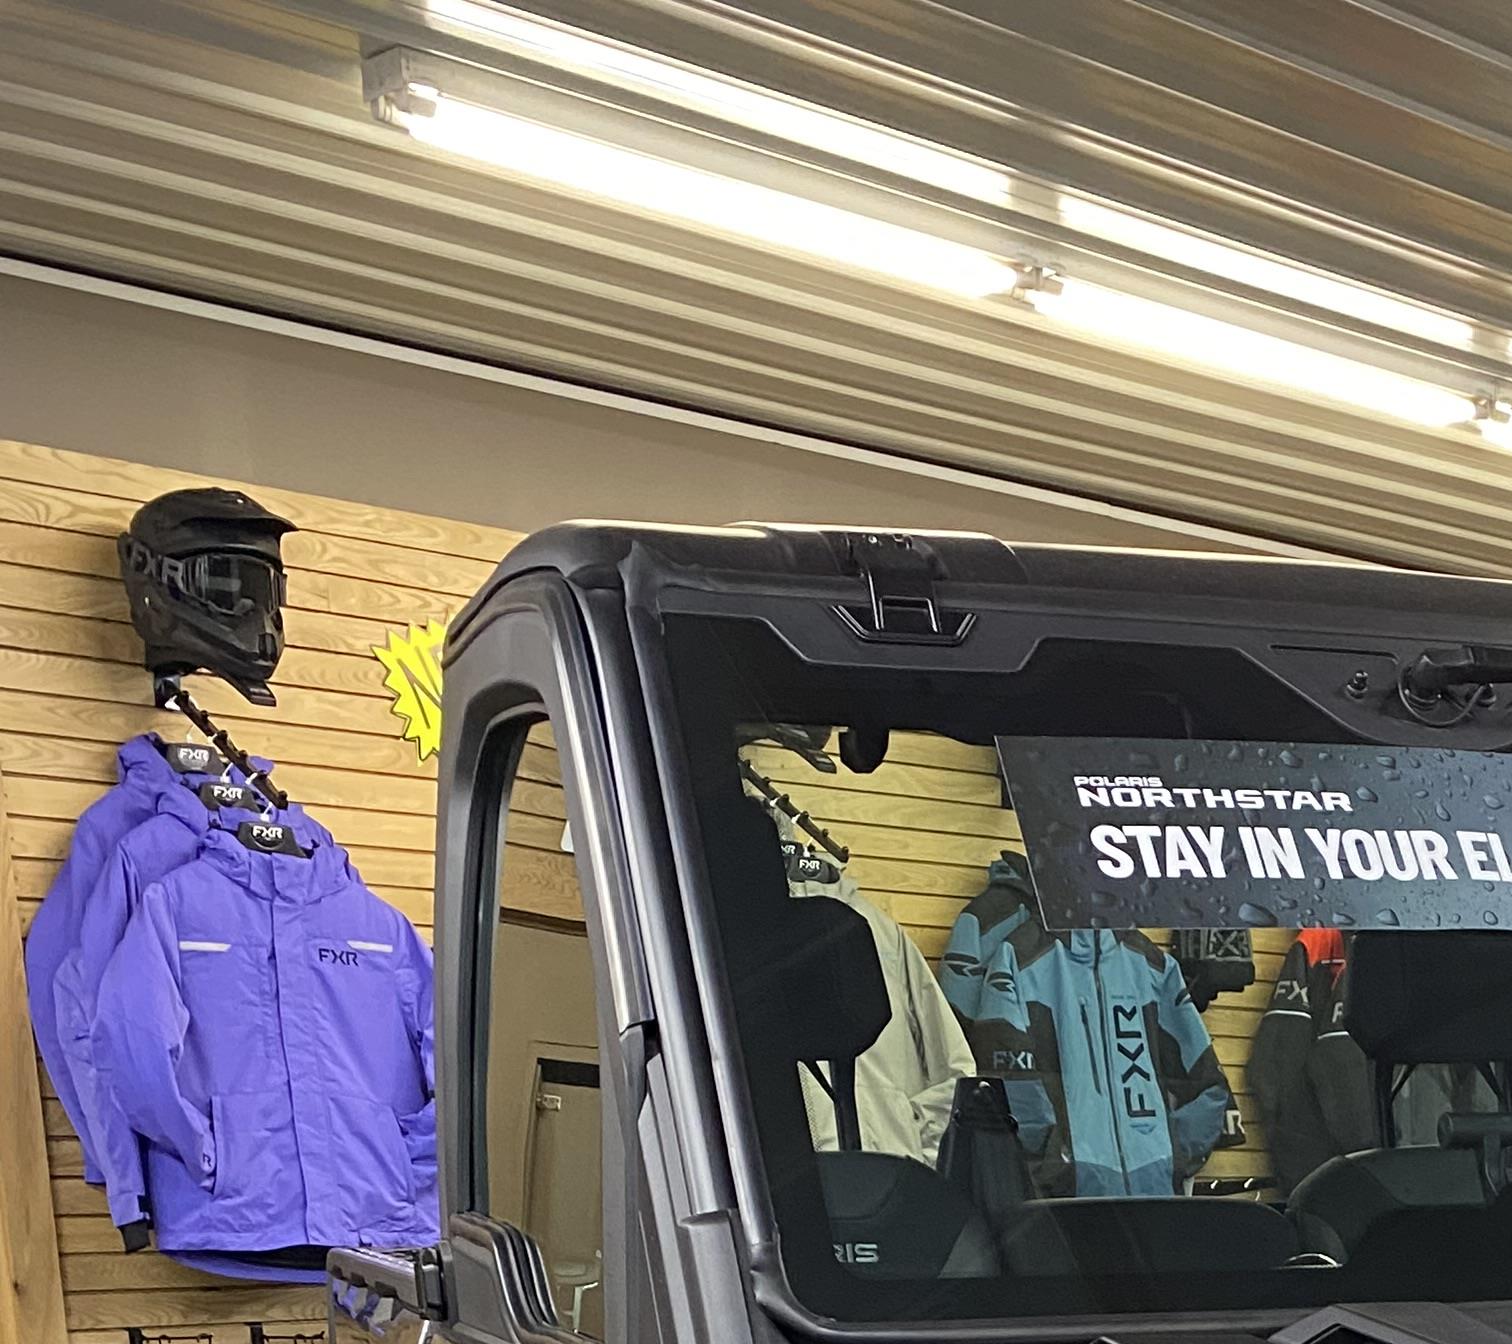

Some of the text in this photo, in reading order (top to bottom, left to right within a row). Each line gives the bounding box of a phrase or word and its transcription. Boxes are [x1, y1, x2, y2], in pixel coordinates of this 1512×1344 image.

[179, 748, 209, 762] FXR
[1073, 775, 1163, 788] POLARIS
[213, 785, 242, 799] FXR
[1076, 787, 1354, 813] NORTHSTAR
[252, 825, 282, 839] FXR
[1089, 824, 1230, 880] STAY
[1237, 826, 1305, 880] IN
[1304, 828, 1459, 882] YOUR
[799, 858, 821, 870] FXR
[319, 948, 359, 967] FXR
[1273, 979, 1310, 1007] FX
[1112, 1004, 1156, 1118] FXR
